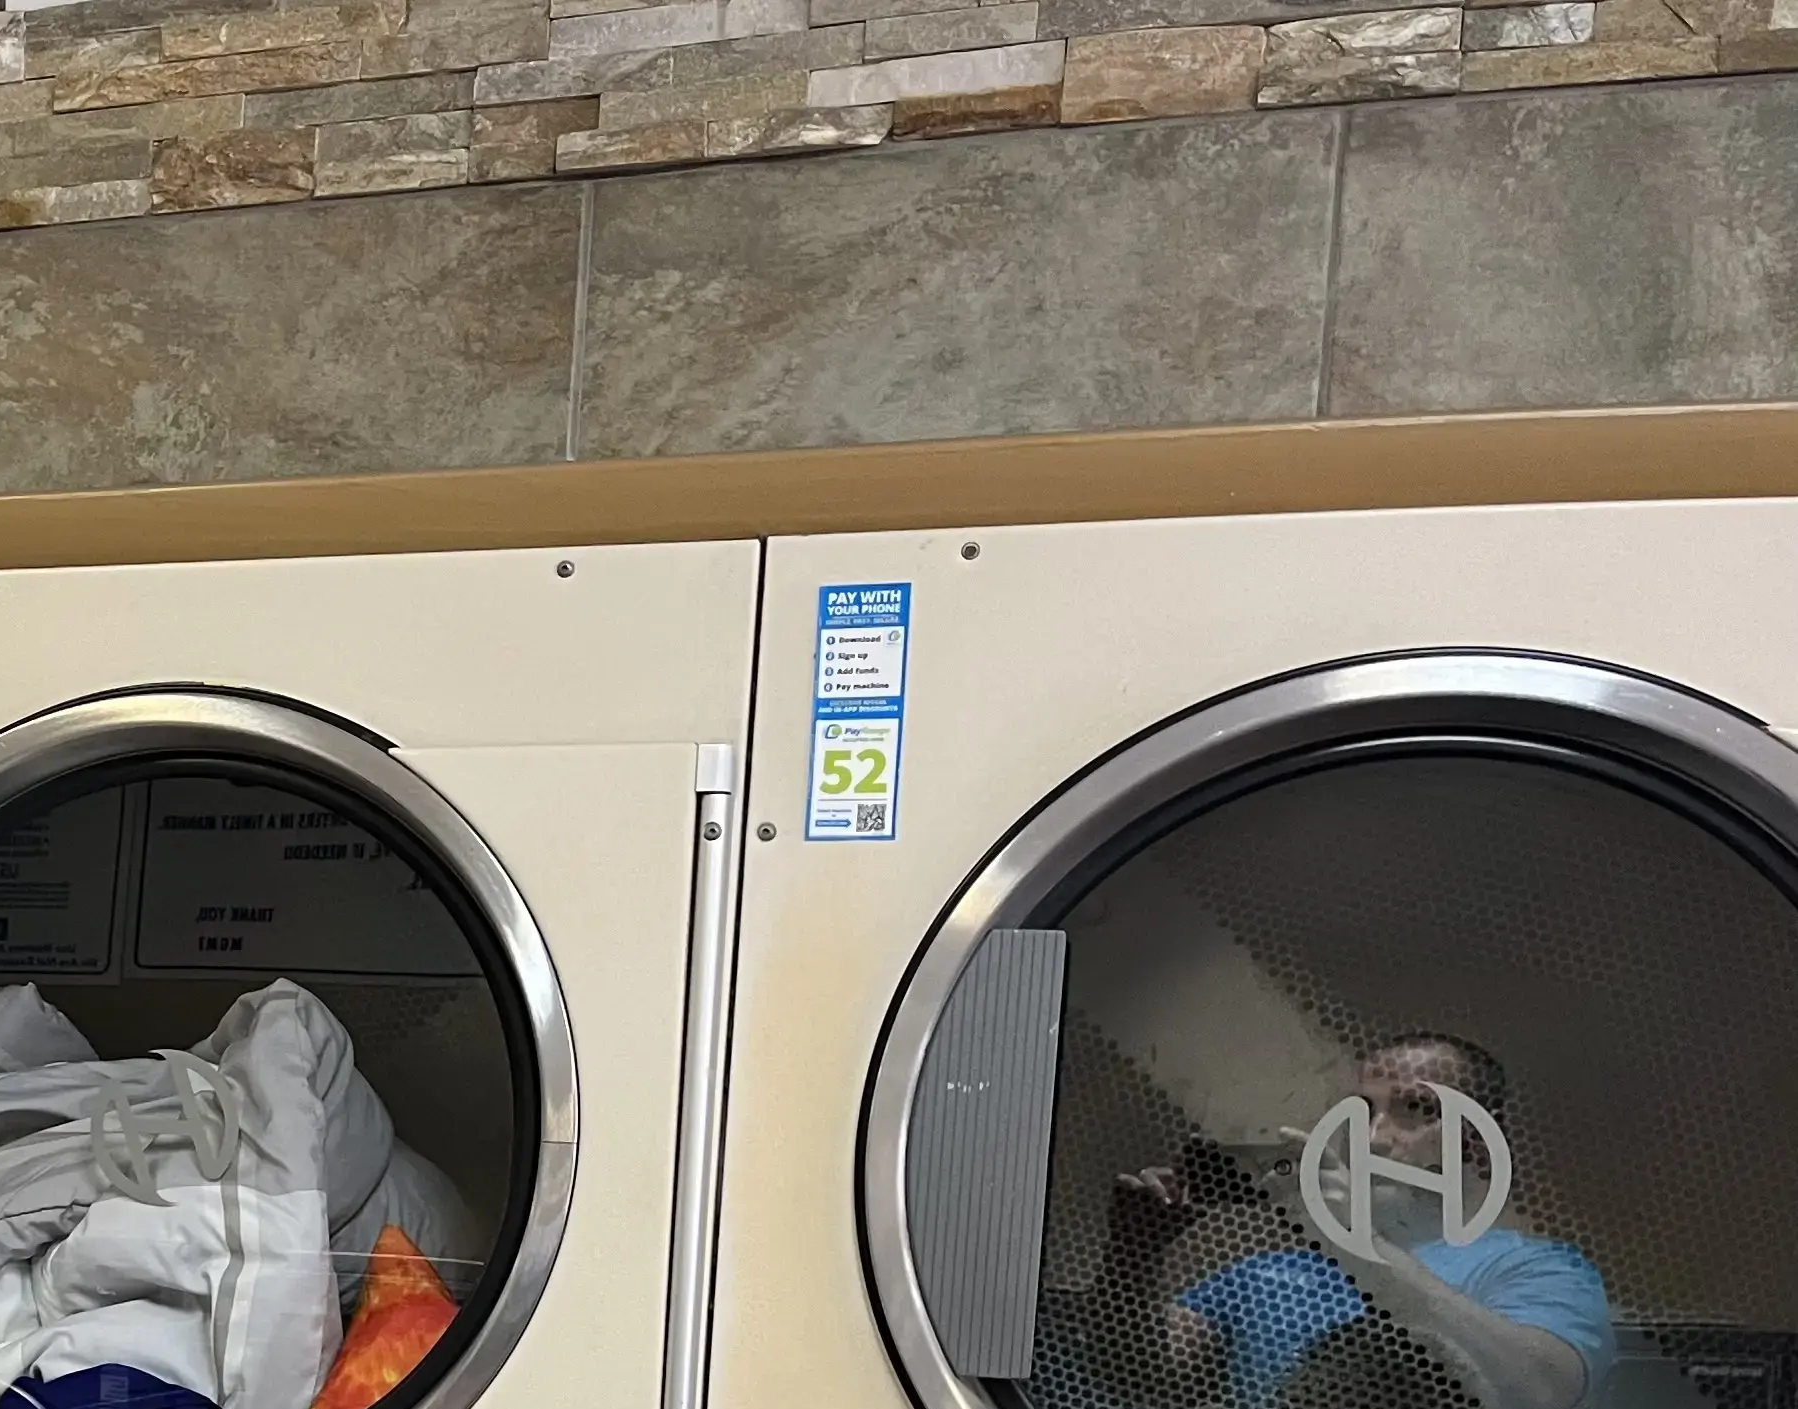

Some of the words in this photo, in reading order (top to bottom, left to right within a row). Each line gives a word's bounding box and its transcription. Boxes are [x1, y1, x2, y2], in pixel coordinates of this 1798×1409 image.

[828, 591, 857, 606] PAY
[860, 589, 902, 604] WITH
[827, 605, 859, 616] YOUR
[861, 603, 900, 614] PHONE
[836, 683, 851, 692] Pay
[819, 749, 888, 794] 52
